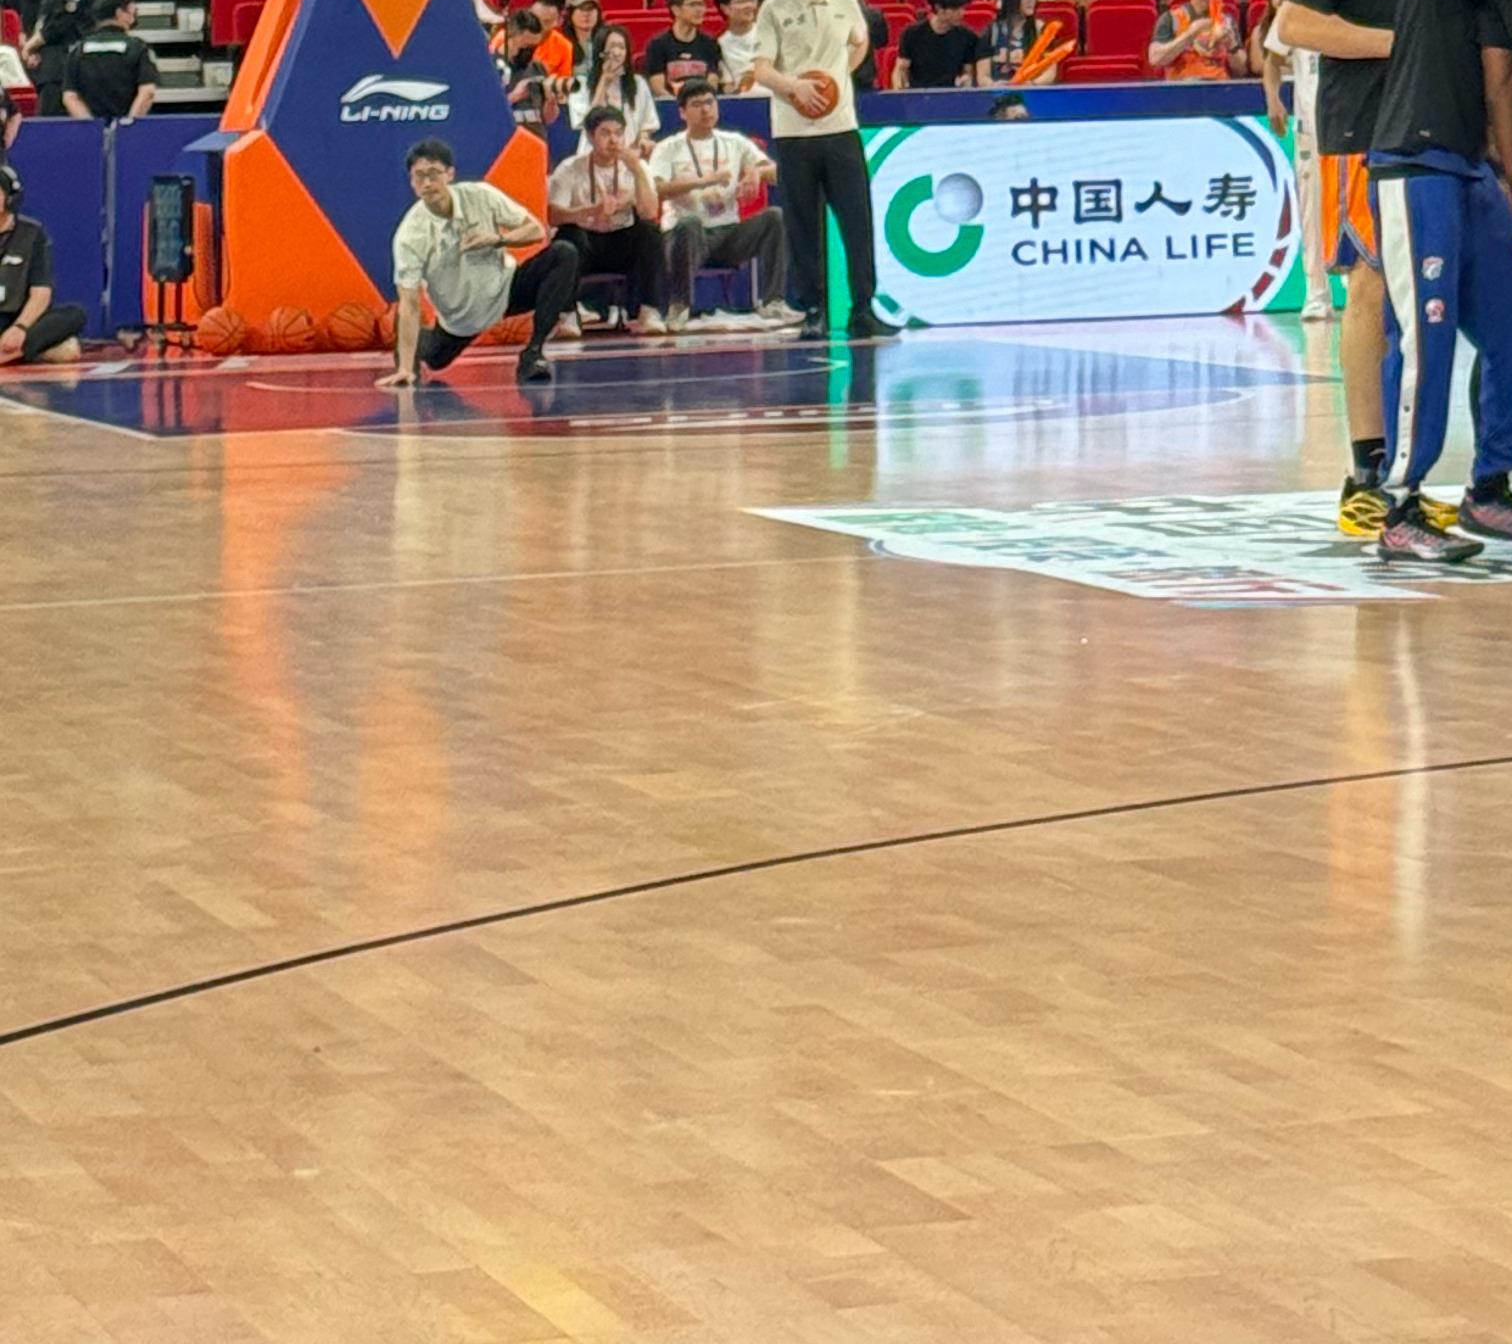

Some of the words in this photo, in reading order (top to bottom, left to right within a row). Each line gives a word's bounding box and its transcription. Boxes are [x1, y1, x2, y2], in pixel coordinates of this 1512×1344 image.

[340, 104, 450, 122] LI-NING
[1008, 172, 1258, 230] 中国人寿
[1011, 237, 1147, 266] CHINA
[1165, 232, 1255, 260] LIFE
